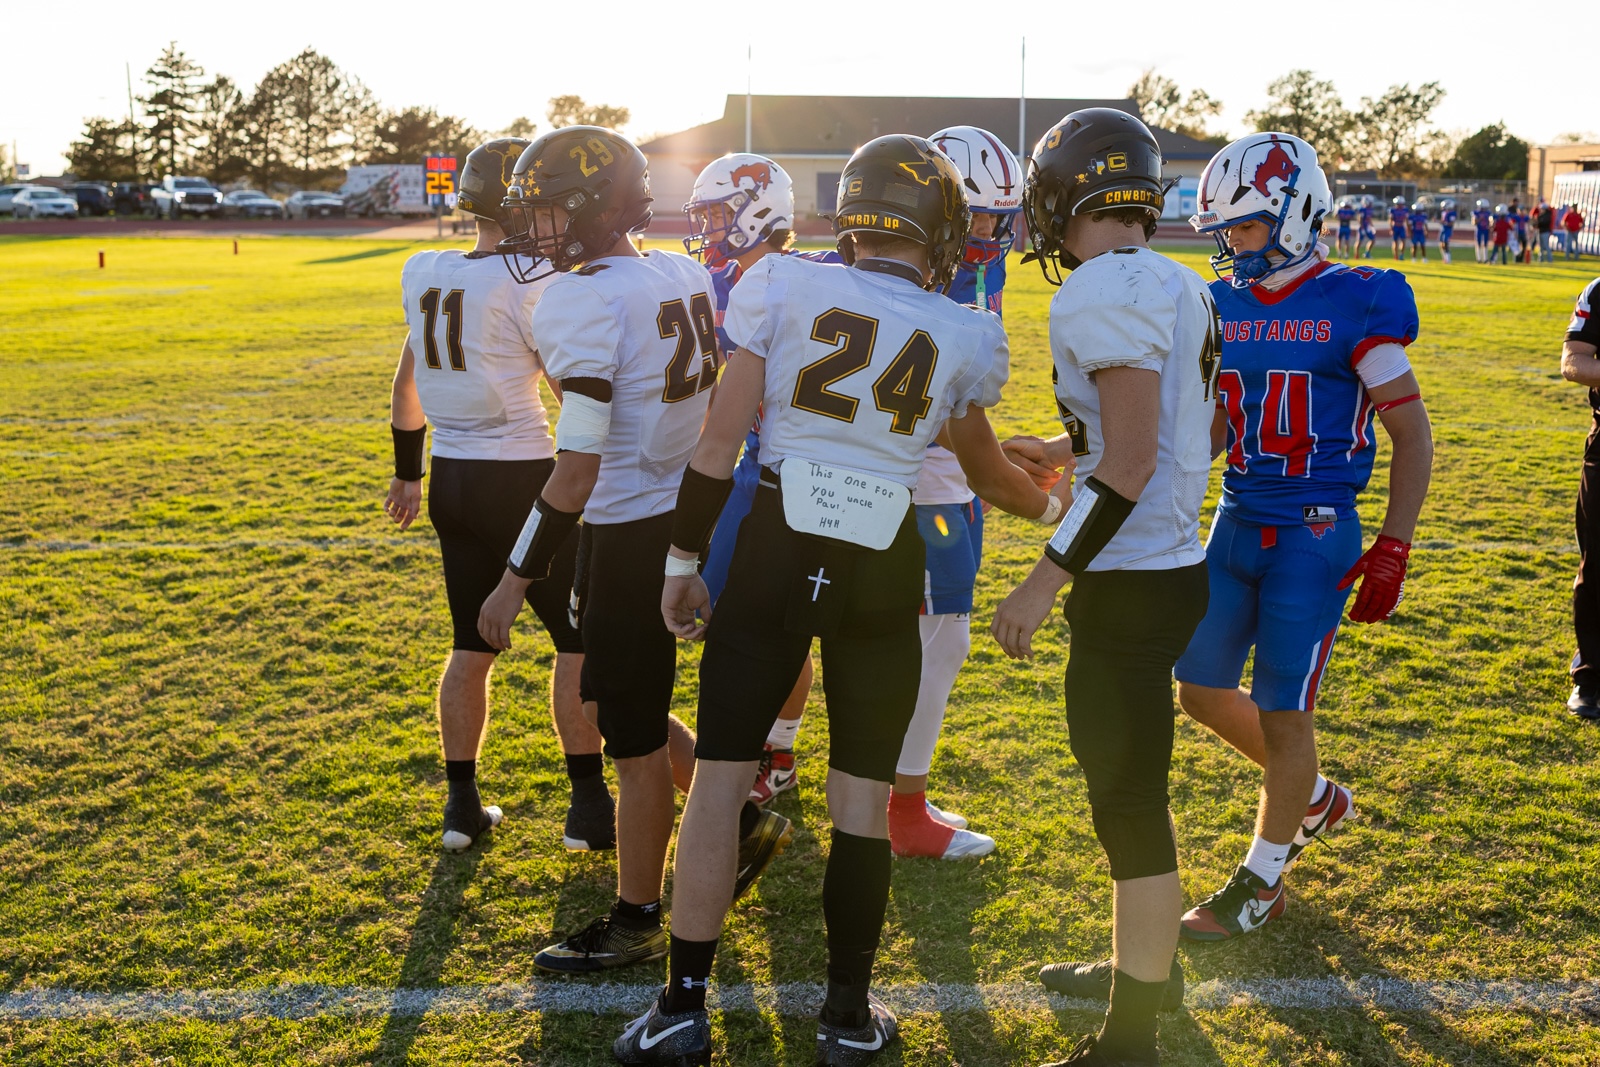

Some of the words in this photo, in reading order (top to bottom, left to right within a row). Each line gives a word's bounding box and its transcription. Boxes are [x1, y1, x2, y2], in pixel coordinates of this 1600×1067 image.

[569, 137, 615, 178] 29
[426, 172, 454, 194] 25
[849, 180, 862, 193] C
[994, 199, 1018, 207] Riddell
[1105, 190, 1150, 204] COWBOY
[838, 214, 878, 229] COWBOY
[883, 216, 899, 229] UP
[419, 287, 467, 372] 11
[1221, 319, 1332, 342] USTANGS
[656, 292, 718, 403] 29
[791, 306, 939, 436] 24
[1218, 369, 1319, 478] 14
[808, 462, 833, 479] This
[847, 496, 873, 509] uncle
